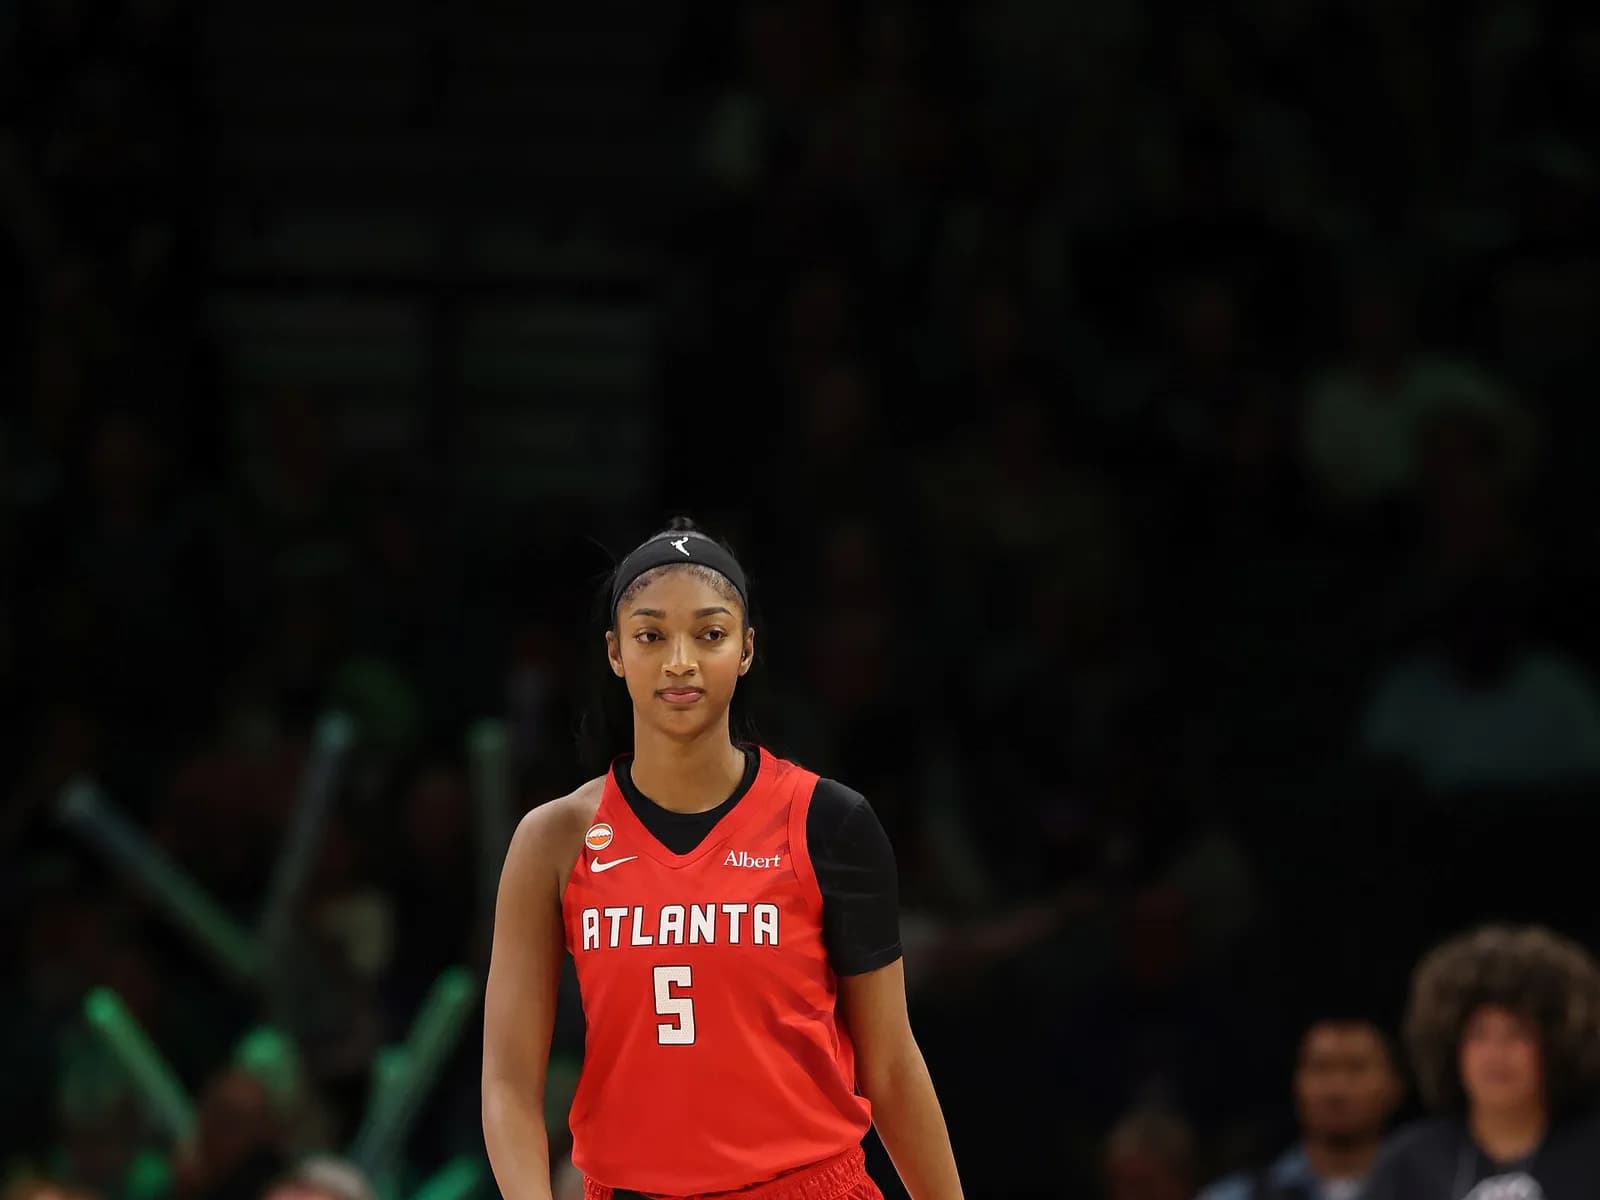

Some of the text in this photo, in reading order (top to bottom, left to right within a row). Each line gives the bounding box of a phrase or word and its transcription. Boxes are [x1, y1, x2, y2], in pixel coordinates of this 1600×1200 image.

[724, 851, 780, 868] Albert
[582, 903, 779, 950] ATLANTA
[653, 965, 696, 1045] 5
